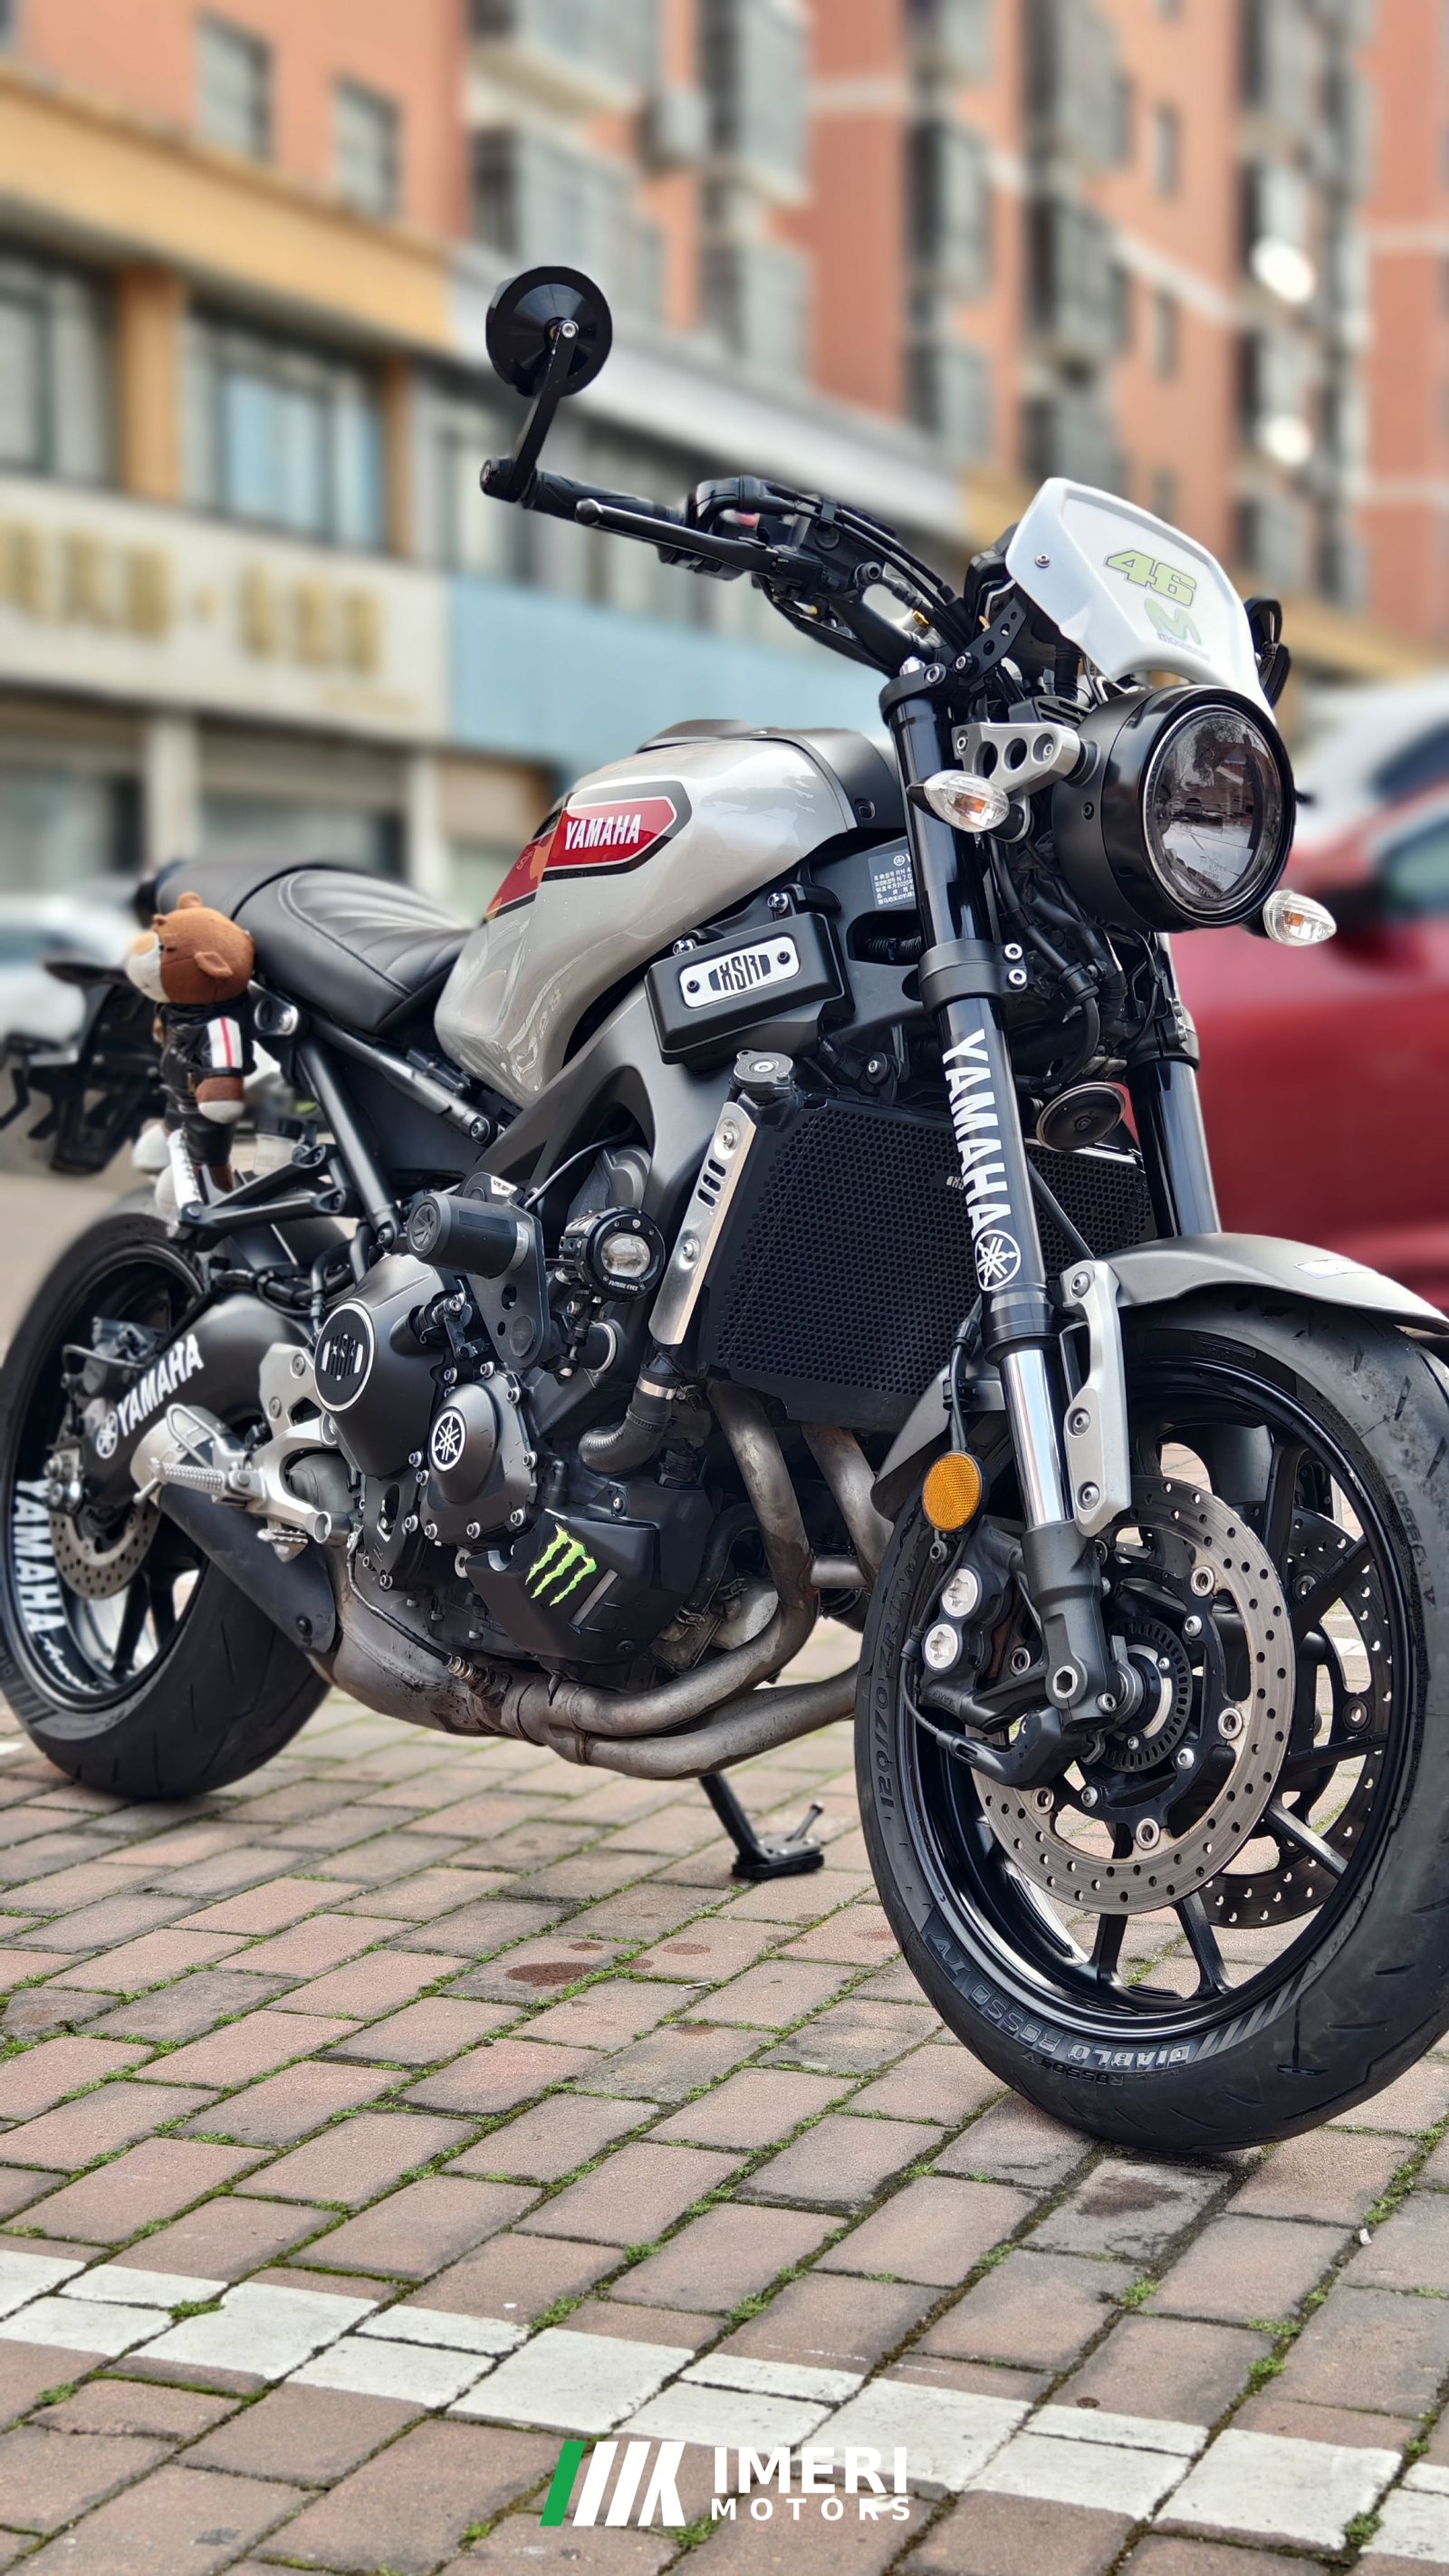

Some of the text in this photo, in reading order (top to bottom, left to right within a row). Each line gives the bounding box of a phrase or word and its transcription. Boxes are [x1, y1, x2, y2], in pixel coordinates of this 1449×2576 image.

[1104, 549, 1197, 607] 46
[565, 813, 641, 851] YAMAHA
[715, 955, 763, 991] XSR
[942, 1028, 1012, 1241] YAMAHA
[117, 1333, 205, 1437] YAMAHA
[14, 1479, 66, 1633] YAMAHA
[874, 1685, 895, 1810] 120/70
[926, 1931, 1191, 2069] DIABLO ROSSO IV
